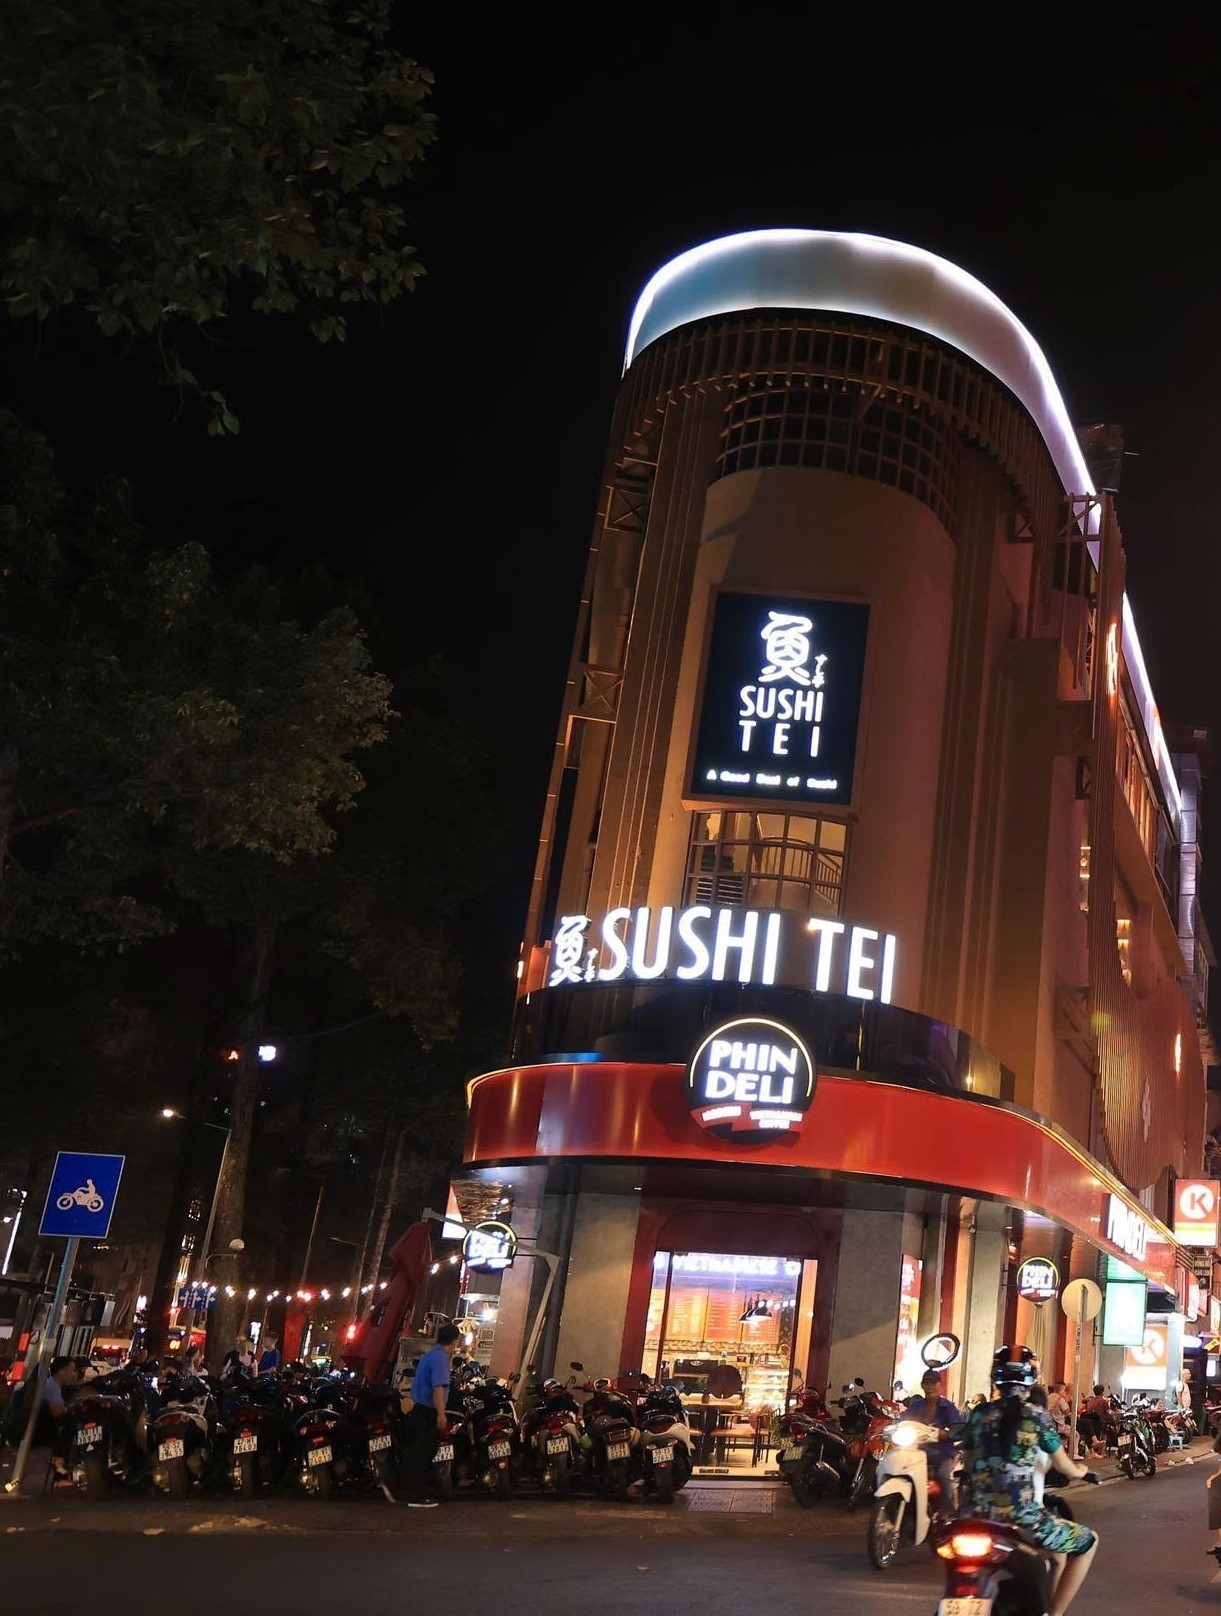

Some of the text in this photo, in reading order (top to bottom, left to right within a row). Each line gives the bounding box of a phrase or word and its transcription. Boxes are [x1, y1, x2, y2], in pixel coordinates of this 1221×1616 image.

[739, 685, 824, 722] SUSHI
[599, 906, 896, 1005] SUSHI TEI
[709, 1040, 798, 1075] PHIN
[705, 1070, 794, 1105] DELI
[1021, 1276, 1053, 1289] DELI
[1022, 1265, 1054, 1278] PHIN
